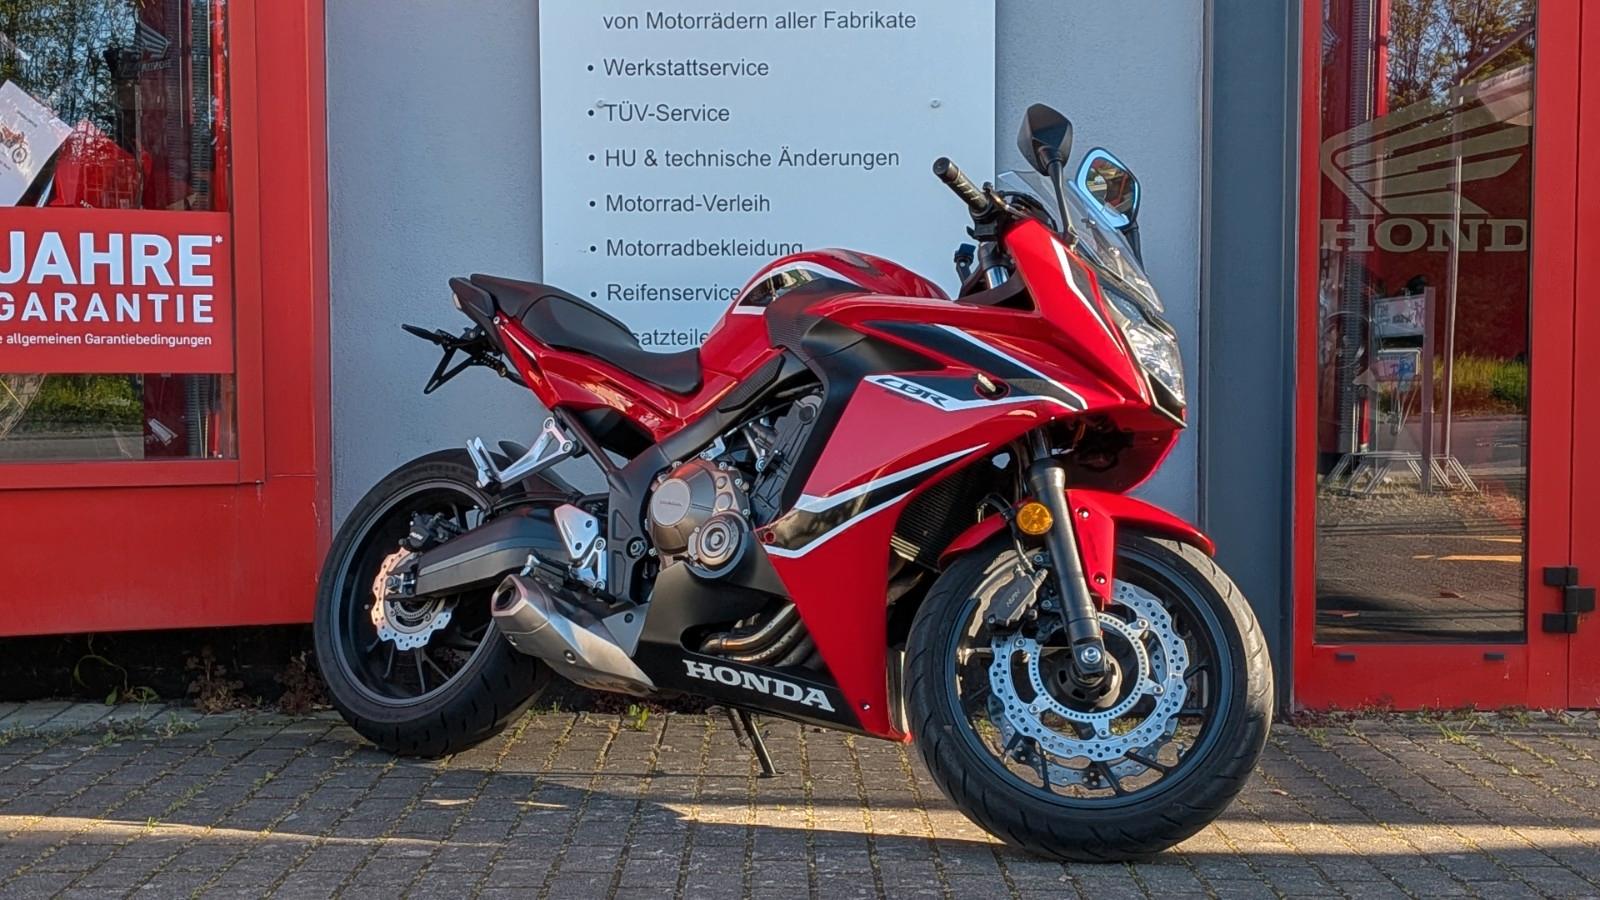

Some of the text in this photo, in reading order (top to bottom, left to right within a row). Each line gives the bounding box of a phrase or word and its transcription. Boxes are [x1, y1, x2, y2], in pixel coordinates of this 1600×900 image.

[602, 11, 917, 30] von Motorrädern aller Fabrikate
[603, 58, 769, 76] Werkstattservice
[605, 101, 730, 121] TÜV-Service
[605, 147, 900, 170] HU & technische Änderungen
[606, 194, 771, 212] Motorrad-Verleih
[606, 239, 803, 257] Motorradbekleidung
[607, 284, 740, 301] Reifenservice
[6, 333, 81, 347] allgemeinen
[84, 333, 212, 348] Garantiebedingungen
[633, 329, 709, 346] satzteile
[875, 378, 949, 408] CBR
[682, 659, 836, 712] HONDA
